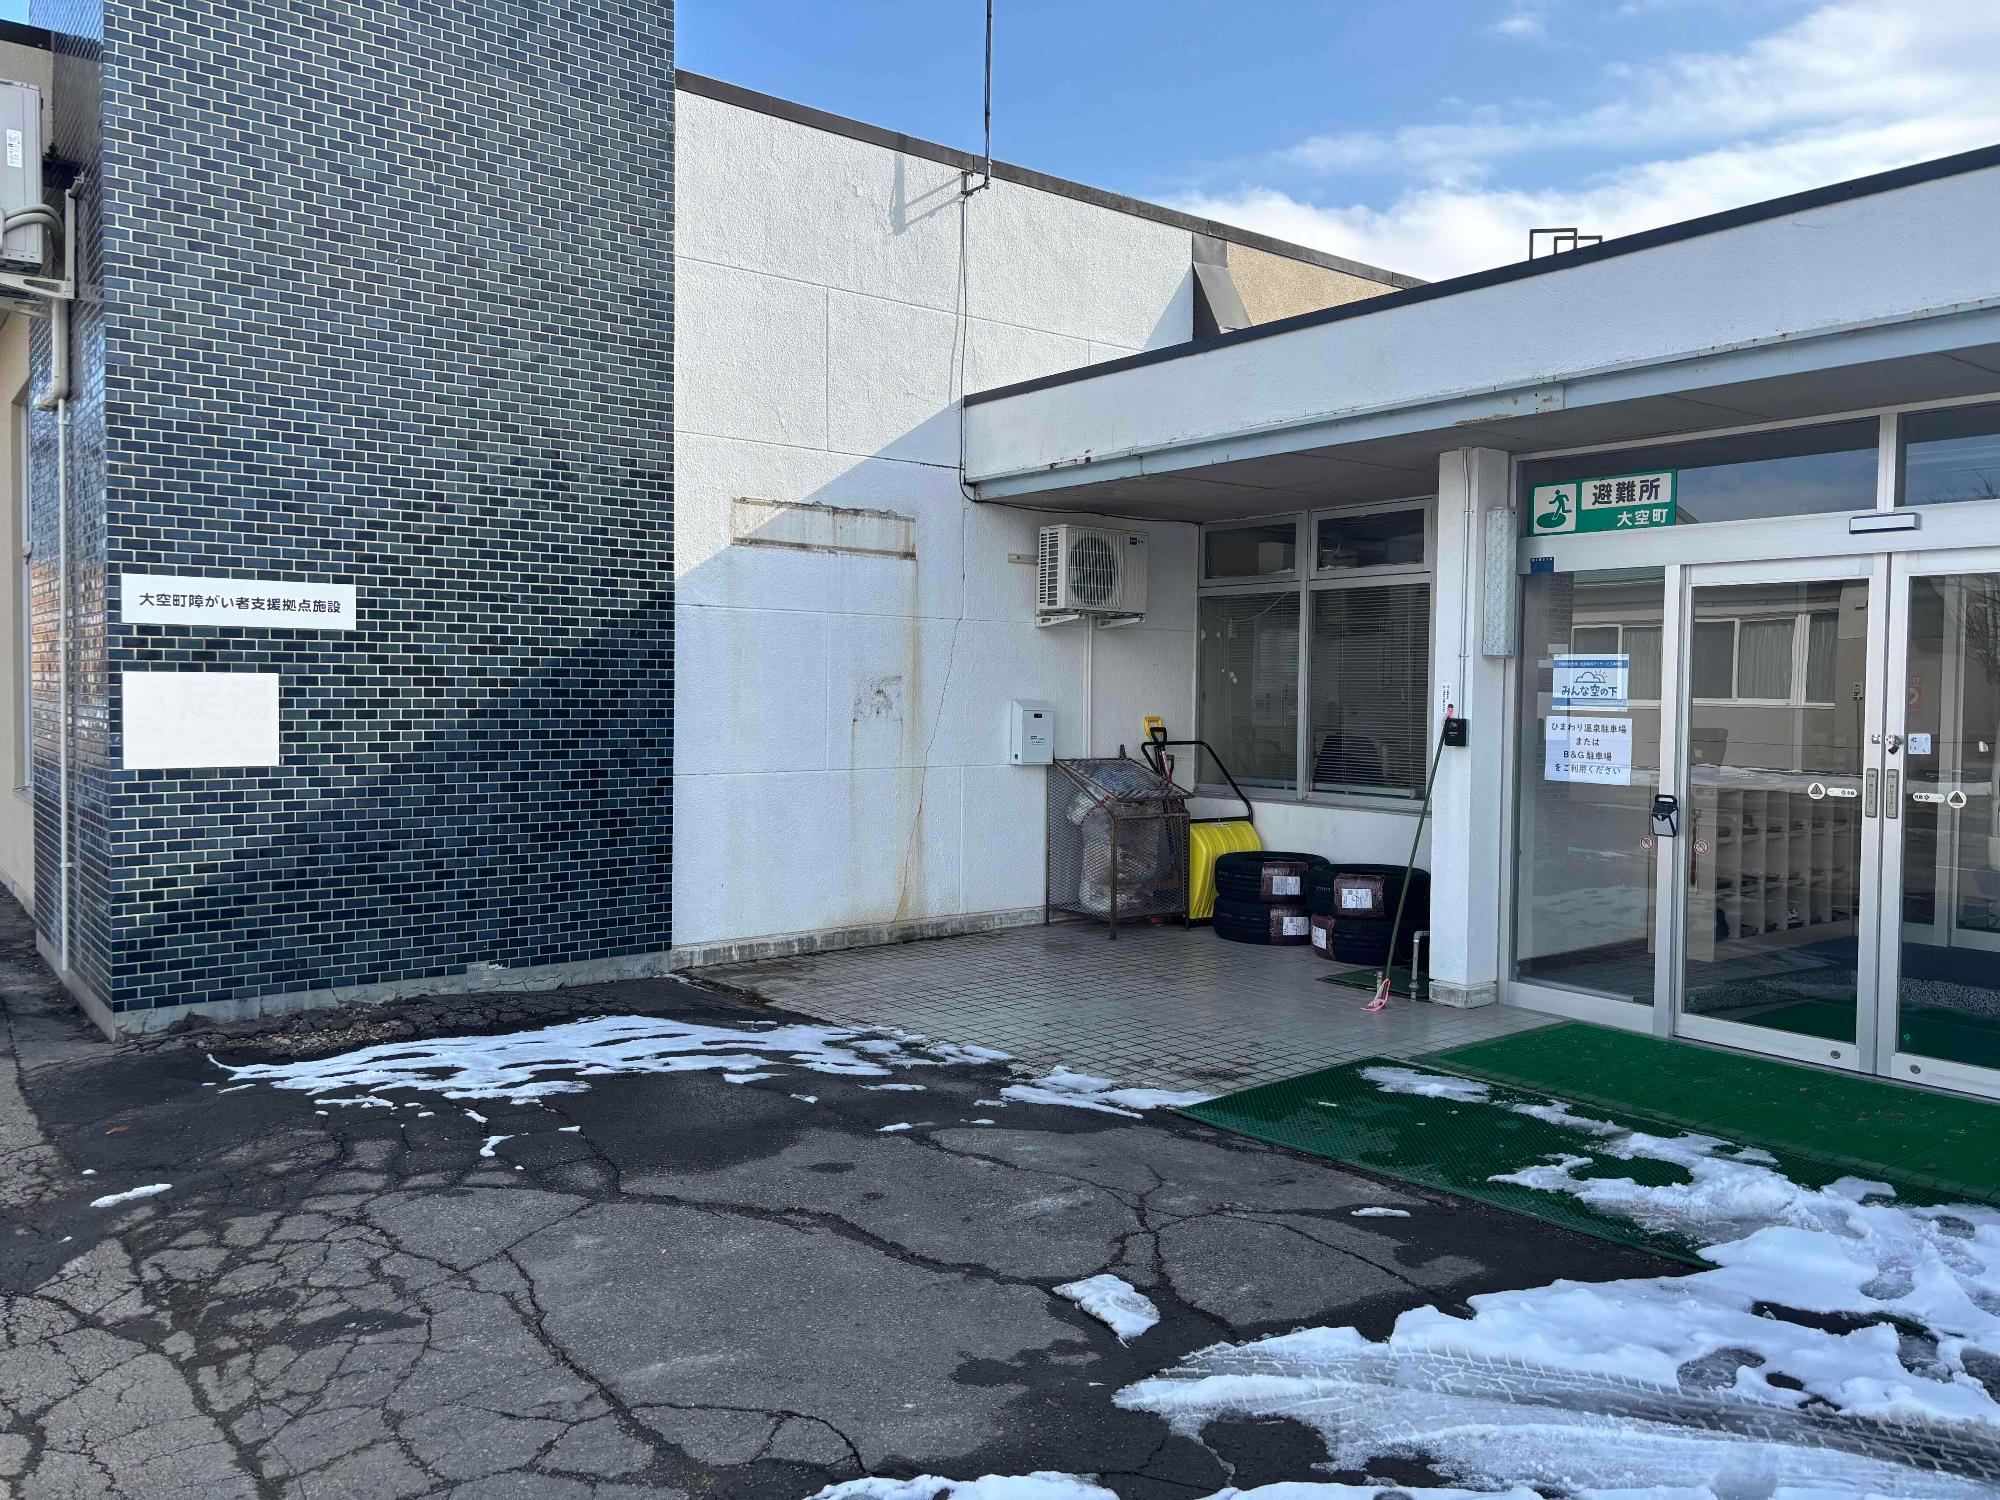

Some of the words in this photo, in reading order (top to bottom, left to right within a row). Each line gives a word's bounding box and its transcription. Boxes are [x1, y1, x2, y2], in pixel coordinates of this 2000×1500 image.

[1591, 477, 1661, 506] 避難所
[1616, 508, 1668, 527] 大空町
[139, 592, 341, 614] 大空町障がい者支援拠点施設
[1561, 683, 1618, 697] みんな空の下
[1551, 722, 1627, 734] ひまわり温泉駐車場
[1575, 736, 1600, 746] または
[1555, 763, 1621, 775] をご利用ください
